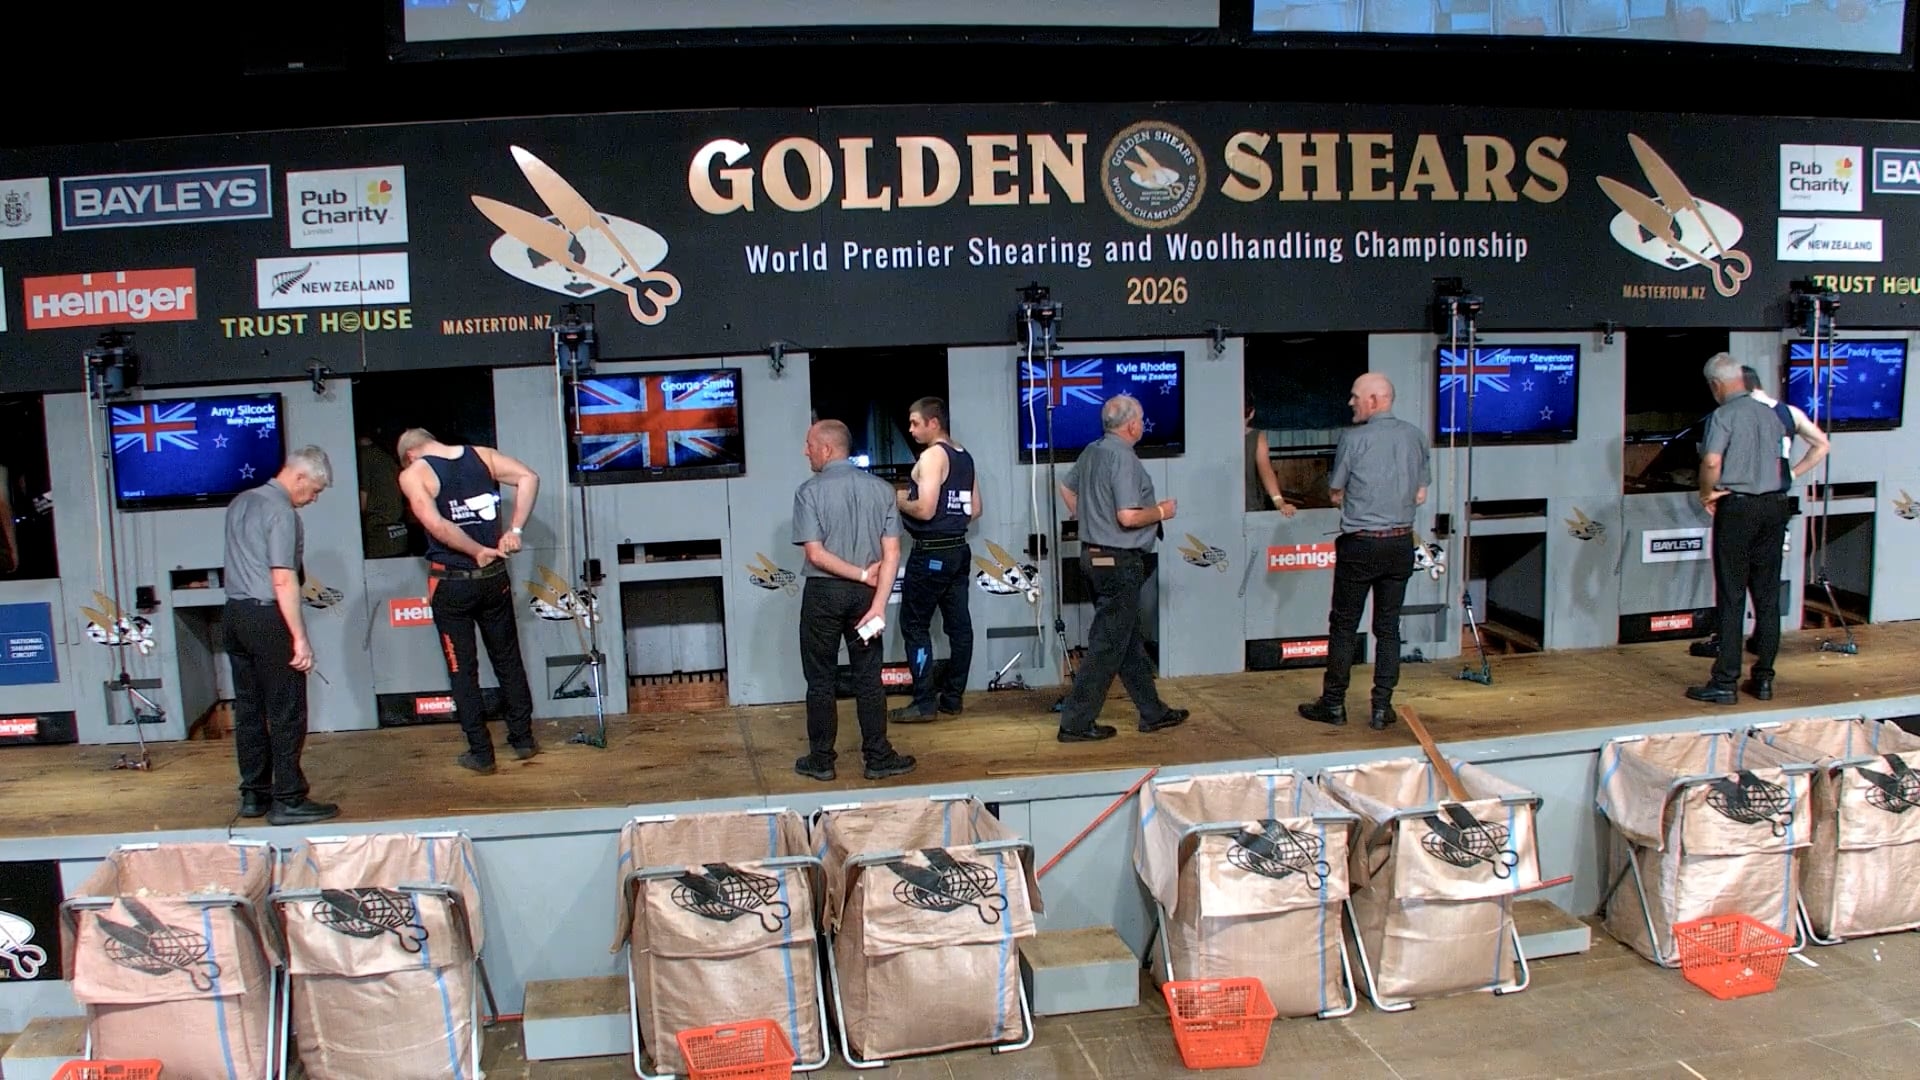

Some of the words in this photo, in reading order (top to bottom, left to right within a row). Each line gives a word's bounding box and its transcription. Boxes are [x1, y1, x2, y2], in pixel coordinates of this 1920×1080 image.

[1112, 130, 1150, 166] GOLDEN
[1154, 130, 1195, 166] SHEARS
[688, 134, 1088, 215] GOLDEN
[1220, 132, 1569, 203] SHEARS
[1789, 161, 1822, 175] Pub
[1111, 176, 1133, 210] WORLD
[1789, 177, 1848, 194] Charity
[74, 178, 257, 217] BAYLEYS
[301, 189, 347, 206] Pub
[302, 206, 388, 225] Charity
[745, 243, 828, 274] World
[843, 240, 955, 270] Premier
[968, 236, 1092, 268] Shearing
[1105, 234, 1151, 262] and
[1166, 231, 1344, 264] Woolhandling
[1354, 231, 1529, 263] Championship
[1808, 241, 1829, 250] NEW
[1831, 241, 1873, 250] ZEALAND
[302, 283, 331, 293] NEW
[334, 279, 395, 293] ZEALAND
[1127, 277, 1189, 304] 2026
[1622, 285, 1705, 299] MASTERTON.NZ
[1813, 275, 1876, 293] TRUST
[1883, 276, 1920, 294] HOU
[32, 271, 192, 319] Heiniger
[220, 313, 308, 339] TRUST
[321, 309, 413, 334] HOUSE
[442, 314, 551, 335] MASTERTON.NZ
[1116, 363, 1138, 374] Kyle
[1140, 362, 1177, 372] Rhodes
[1495, 354, 1528, 364] Tommy
[1529, 353, 1573, 363] Stevenson
[661, 382, 700, 392] George
[702, 379, 734, 389] Smith
[211, 407, 235, 418] Amy
[238, 404, 275, 415] Silcock
[1653, 540, 1700, 551] BAYLEYS
[1271, 544, 1336, 567] Heinige
